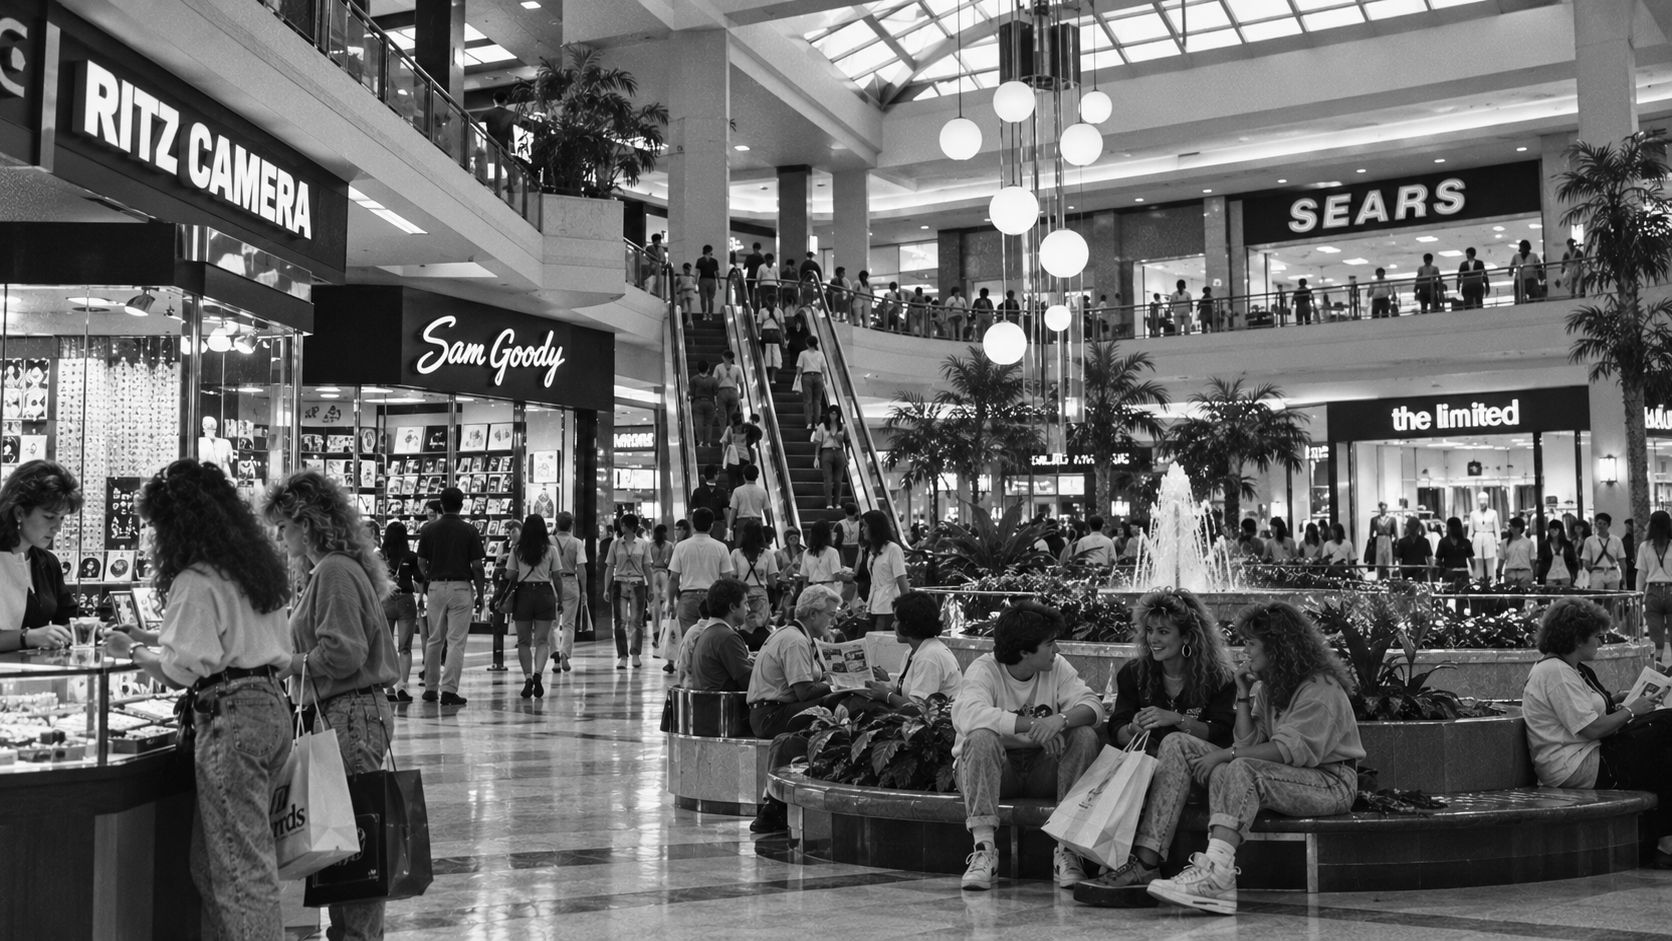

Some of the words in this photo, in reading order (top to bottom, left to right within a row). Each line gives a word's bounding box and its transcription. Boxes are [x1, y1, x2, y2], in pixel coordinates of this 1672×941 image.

[84, 59, 180, 176] RITZ
[188, 122, 312, 240] CAMERA
[1288, 178, 1466, 233] SEARS
[416, 315, 486, 375] Sam
[489, 328, 566, 389] Goody
[1391, 405, 1432, 432] the
[1436, 398, 1520, 429] limited
[270, 803, 306, 838] rrds
